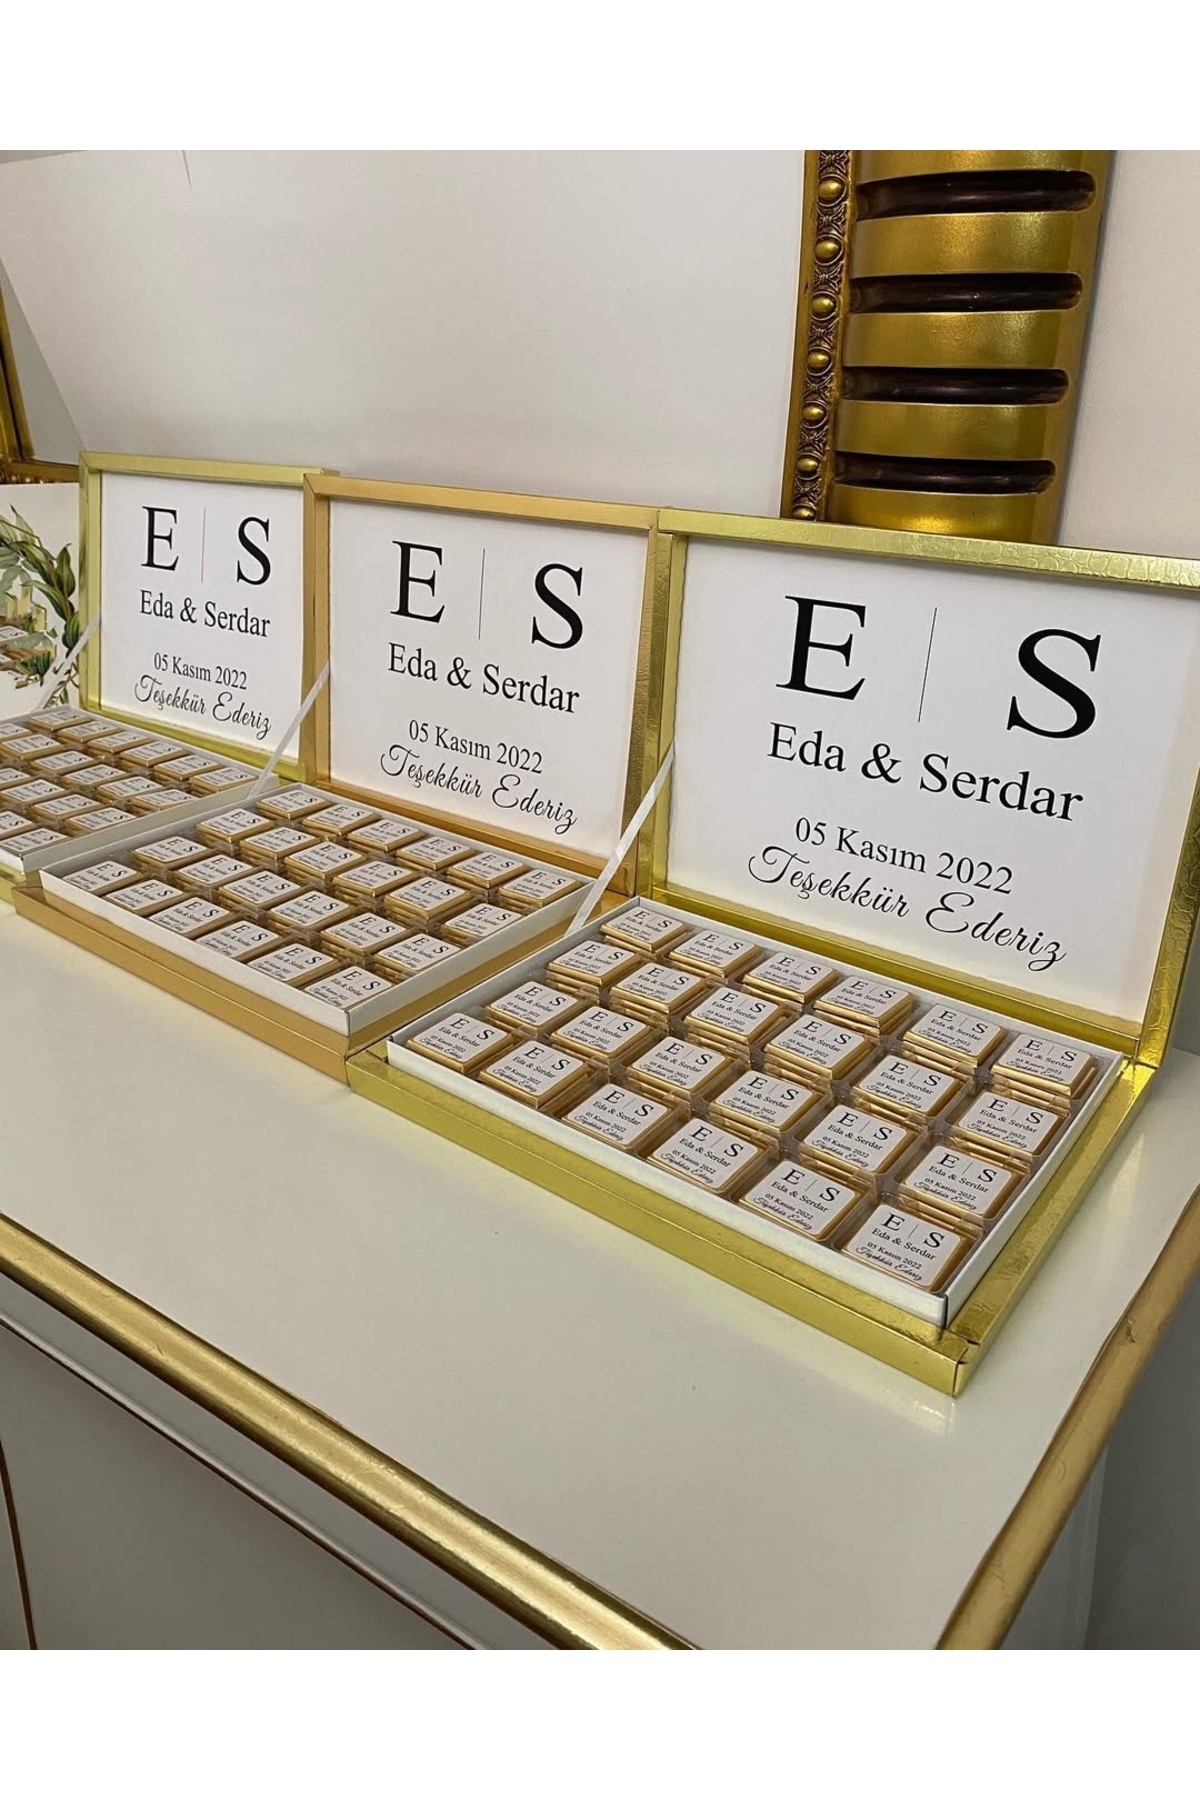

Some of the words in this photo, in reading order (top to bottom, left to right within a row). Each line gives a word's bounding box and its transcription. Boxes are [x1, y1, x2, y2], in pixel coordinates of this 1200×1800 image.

[141, 505, 179, 571] E
[236, 516, 271, 585] S
[390, 540, 446, 624] E
[531, 563, 584, 650] S
[140, 589, 174, 619] Eda
[179, 597, 197, 623] &
[204, 600, 271, 638] Serdar
[153, 652, 169, 672] 05
[172, 656, 212, 682] Kasım
[215, 665, 248, 690] 2022
[387, 642, 439, 681] Eda
[446, 656, 472, 689] &
[482, 663, 580, 714] Serdar
[775, 595, 867, 701] E
[1006, 628, 1102, 739] S
[134, 674, 206, 715] Teşekkür
[212, 691, 272, 740] Ederiz
[408, 719, 429, 743] 05
[434, 725, 491, 760] Kasım
[496, 742, 543, 774] 2022
[767, 721, 847, 773] Eda
[860, 743, 902, 784] &
[919, 753, 1084, 822] Serdar
[380, 744, 483, 798] Teşekkür
[491, 773, 577, 834] Ederiz
[795, 817, 827, 846] 05
[835, 826, 927, 874] Kasım
[935, 852, 1013, 895] 2022
[183, 901, 202, 910] E
[303, 894, 321, 902] E
[748, 845, 910, 918] Teşekkür
[925, 891, 1067, 972] Ederiz
[358, 916, 377, 924] E
[633, 911, 650, 919] E
[231, 924, 250, 933] E
[284, 947, 304, 956] E
[411, 937, 430, 945] E
[582, 944, 601, 952] E
[702, 934, 719, 942] E
[728, 942, 744, 950] S
[776, 957, 795, 966] E
[341, 970, 362, 980] E
[362, 982, 381, 990] S
[645, 967, 664, 976] E
[673, 977, 690, 985] S
[523, 986, 543, 996] E
[549, 997, 566, 1006] S
[849, 980, 868, 990] E
[879, 990, 897, 998] S
[719, 992, 738, 1003] E
[749, 1003, 766, 1012] S
[449, 1018, 470, 1029] E
[476, 1030, 495, 1039] S
[588, 1011, 608, 1021] E
[617, 1022, 634, 1031] S
[802, 1020, 822, 1032] E
[833, 1034, 852, 1044] S
[937, 1010, 956, 1021] E
[971, 1023, 988, 1033] S
[601, 1028, 623, 1038] Serdar
[523, 1047, 544, 1059] E
[551, 1059, 571, 1070] S
[664, 1042, 684, 1054] E
[694, 1054, 713, 1065] S
[1023, 1039, 1043, 1051] E
[1060, 1051, 1077, 1061] S
[513, 1057, 526, 1065] Eda
[533, 1066, 556, 1078] Serdar
[678, 1061, 702, 1072] Serdar
[888, 1061, 908, 1074] E
[923, 1075, 941, 1086] S
[746, 1076, 768, 1089] E
[780, 1089, 799, 1100] S
[880, 1072, 896, 1081] Eda
[907, 1082, 934, 1094] Serdar
[602, 1090, 625, 1103] E
[634, 1104, 654, 1116] S
[738, 1087, 753, 1095] Eda
[763, 1096, 789, 1108] Serdar
[593, 1102, 608, 1111] Eda
[616, 1112, 641, 1125] Serdar
[980, 1110, 996, 1118] Eda
[1009, 1119, 1038, 1133] Serdar
[987, 1098, 1008, 1111] E
[1025, 1112, 1044, 1124] S
[828, 1125, 844, 1134] Eda
[855, 1135, 883, 1150] Serdar
[836, 1112, 858, 1127] E
[873, 1127, 893, 1140] S
[679, 1138, 695, 1149] Eda
[705, 1151, 731, 1167] Serdar
[689, 1126, 712, 1141] E
[723, 1144, 744, 1157] S
[937, 1153, 959, 1168] E
[977, 1169, 997, 1182] S
[781, 1168, 805, 1185] E
[819, 1187, 840, 1201] S
[929, 1166, 946, 1176] Eda
[959, 1177, 989, 1193] Serdar
[771, 1181, 788, 1193] Eda
[800, 1195, 829, 1212] Serdar
[880, 1213, 905, 1231] E
[923, 1232, 945, 1248] S
[872, 1228, 890, 1240] Eda
[904, 1242, 936, 1260] Serdar
